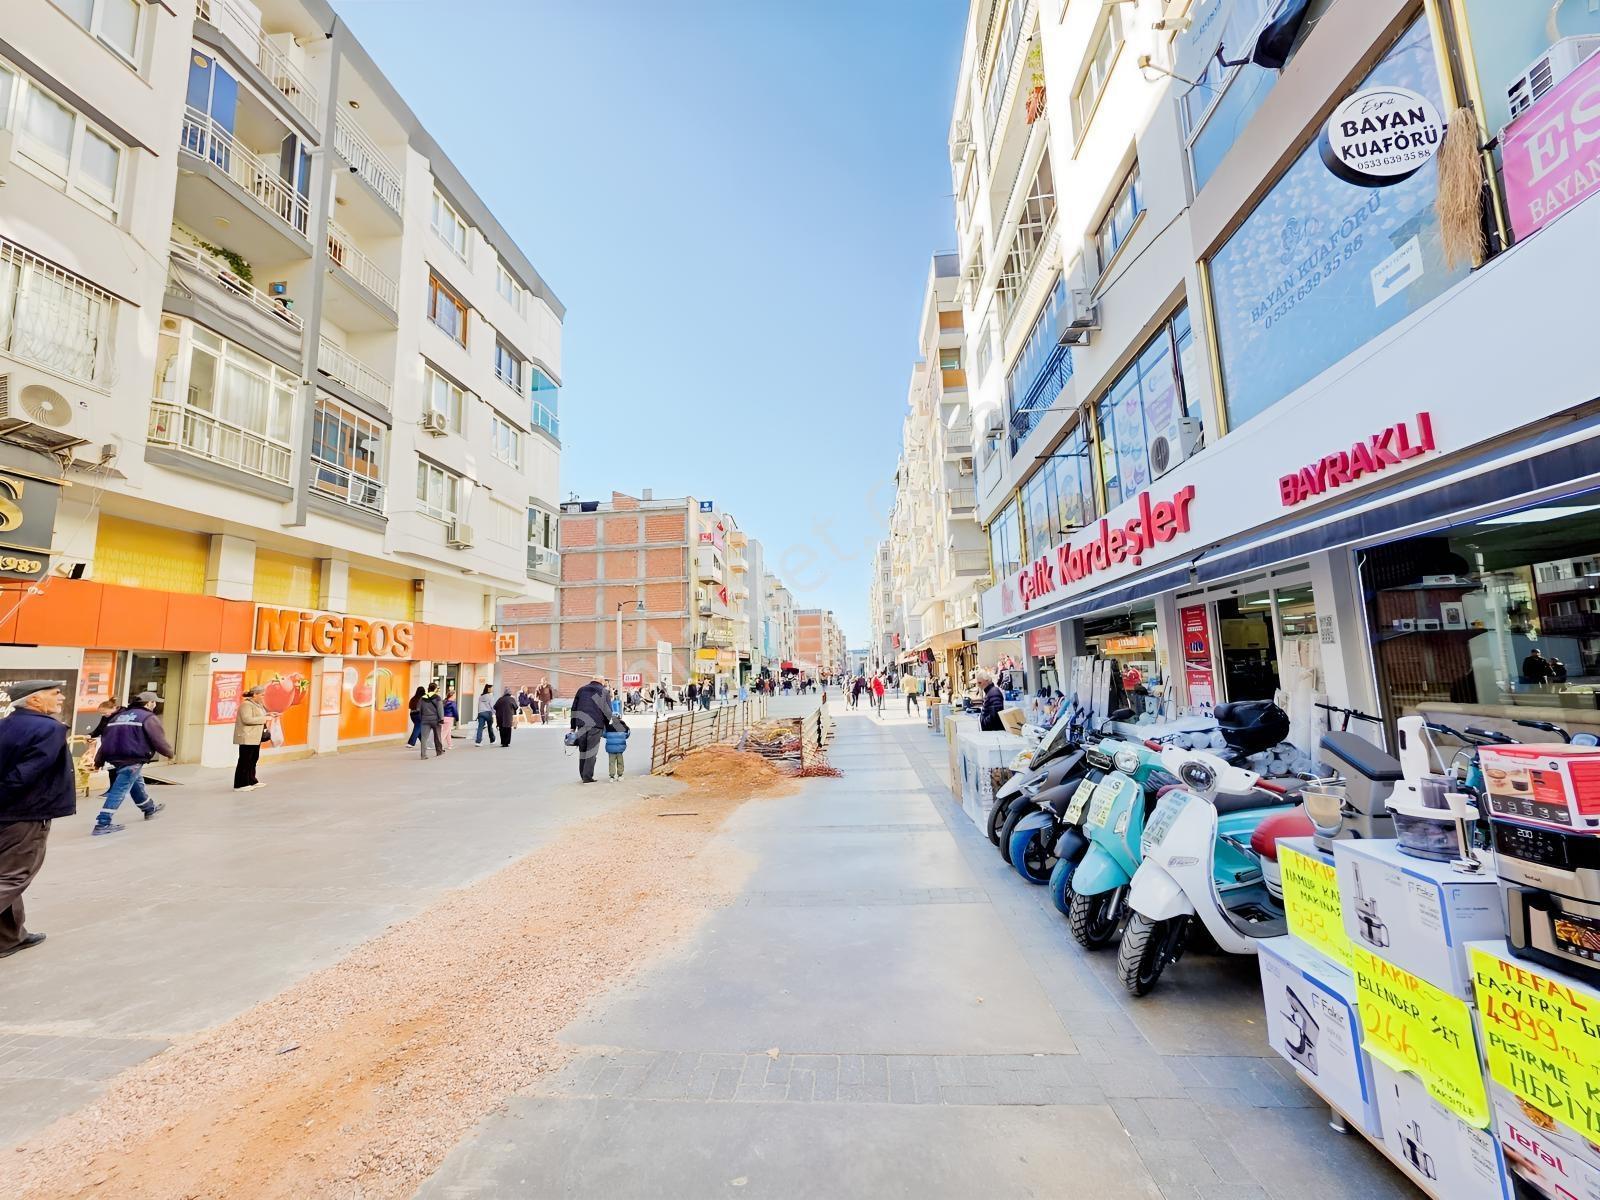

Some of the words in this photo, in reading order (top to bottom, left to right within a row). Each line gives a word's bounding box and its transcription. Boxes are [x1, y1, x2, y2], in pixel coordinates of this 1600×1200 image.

[1340, 107, 1426, 138] BAYAN
[1341, 124, 1438, 161] KUAFÖRÜ
[1357, 159, 1382, 170] 0533
[1383, 154, 1402, 165] 639
[1404, 151, 1416, 161] 35
[1418, 149, 1431, 158] 88
[1251, 272, 1294, 323] BAYAN
[1297, 189, 1382, 279] KUAFÖRÜ
[1297, 271, 1321, 301] 639
[1323, 253, 1341, 278] 35
[1344, 234, 1364, 260] 88
[1279, 412, 1435, 506] BAYRAKLI
[1018, 555, 1056, 610] Çelik
[1057, 485, 1196, 586] Kardeşler
[1357, 971, 1423, 1025] BLENDER
[1477, 972, 1522, 1003] EASY
[1498, 960, 1588, 1012] TEFAL
[1366, 1003, 1420, 1065] 266
[1487, 995, 1559, 1053] 4999
[1504, 1121, 1569, 1178] Tefal
